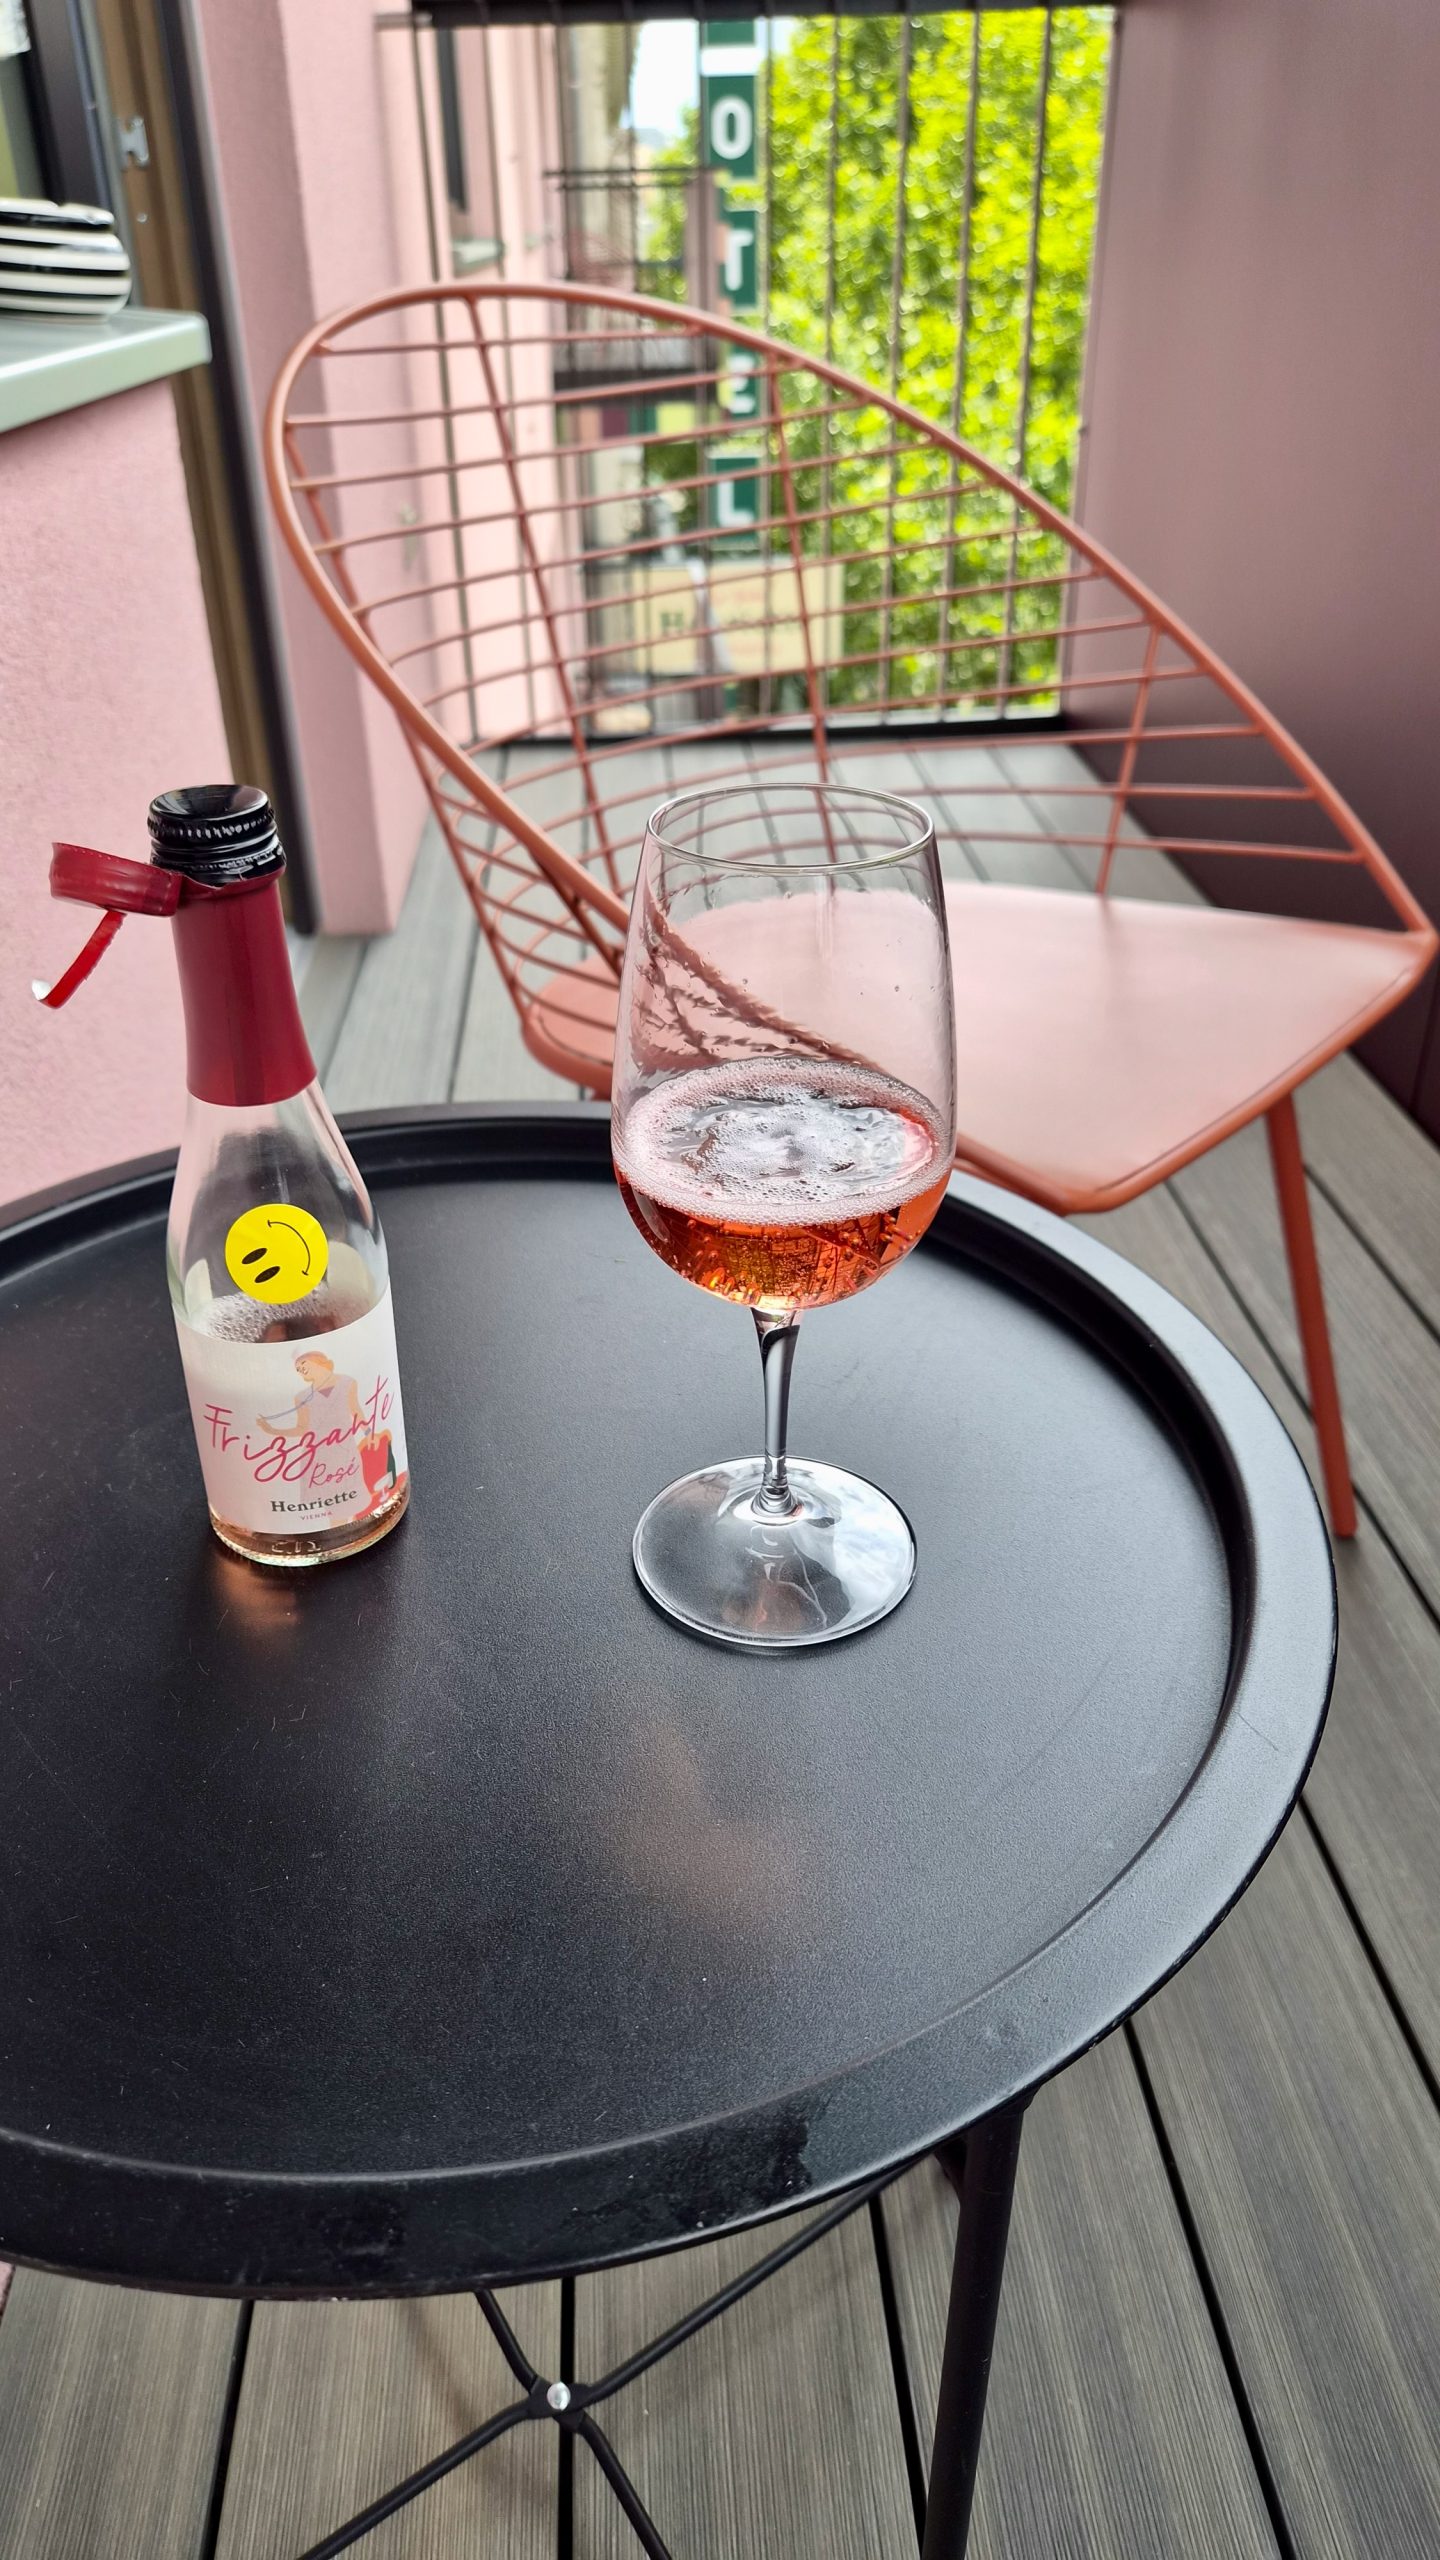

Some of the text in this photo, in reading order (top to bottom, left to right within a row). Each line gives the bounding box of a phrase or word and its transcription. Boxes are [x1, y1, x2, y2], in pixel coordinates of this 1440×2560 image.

[203, 1374, 395, 1483] Frizzante
[308, 1457, 360, 1489] Rosé
[270, 1489, 358, 1513] Henriette
[300, 1510, 333, 1521] VIENNA
